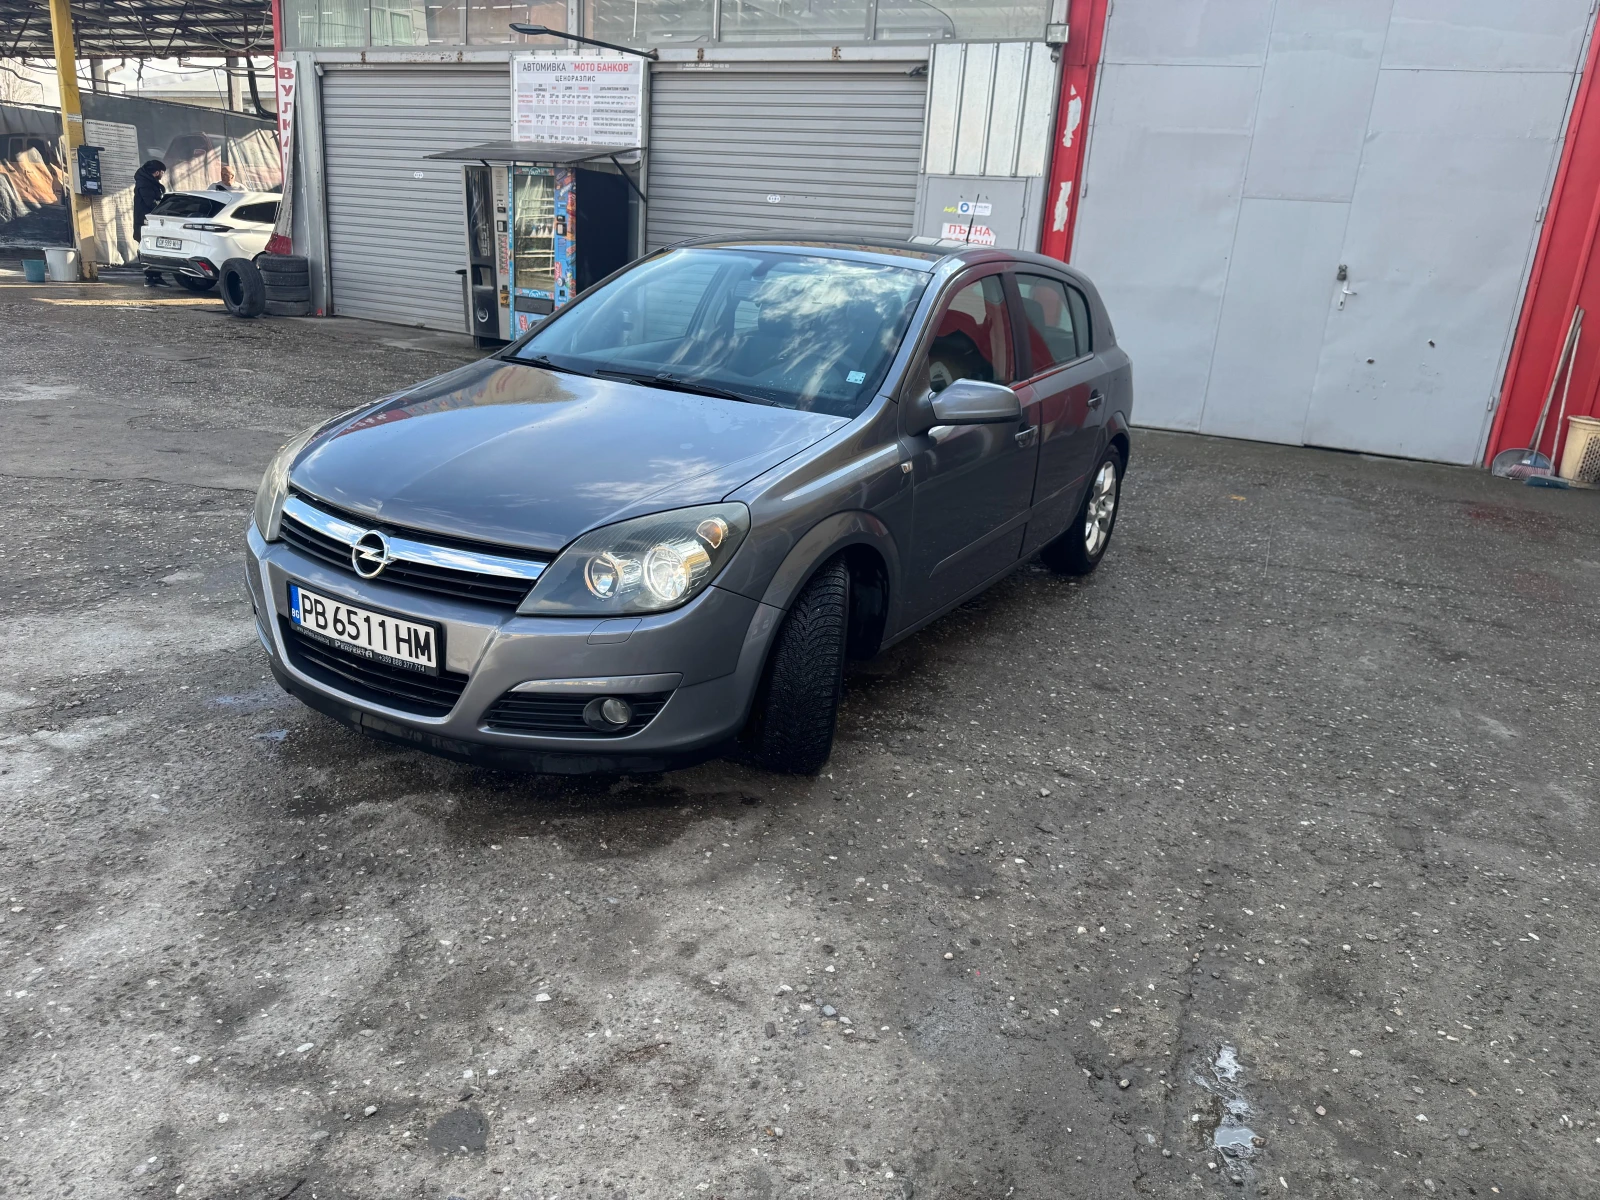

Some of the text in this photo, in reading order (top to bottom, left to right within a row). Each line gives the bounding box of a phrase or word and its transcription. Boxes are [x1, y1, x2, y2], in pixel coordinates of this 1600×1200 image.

[522, 62, 633, 72] АВТОМИВКА "МОТО БАНКОВ"
[291, 608, 300, 619] BG
[301, 593, 432, 662] PB 6511 HM
[378, 654, 392, 664] +359
[403, 660, 414, 670] 377
[414, 663, 425, 673] 714
